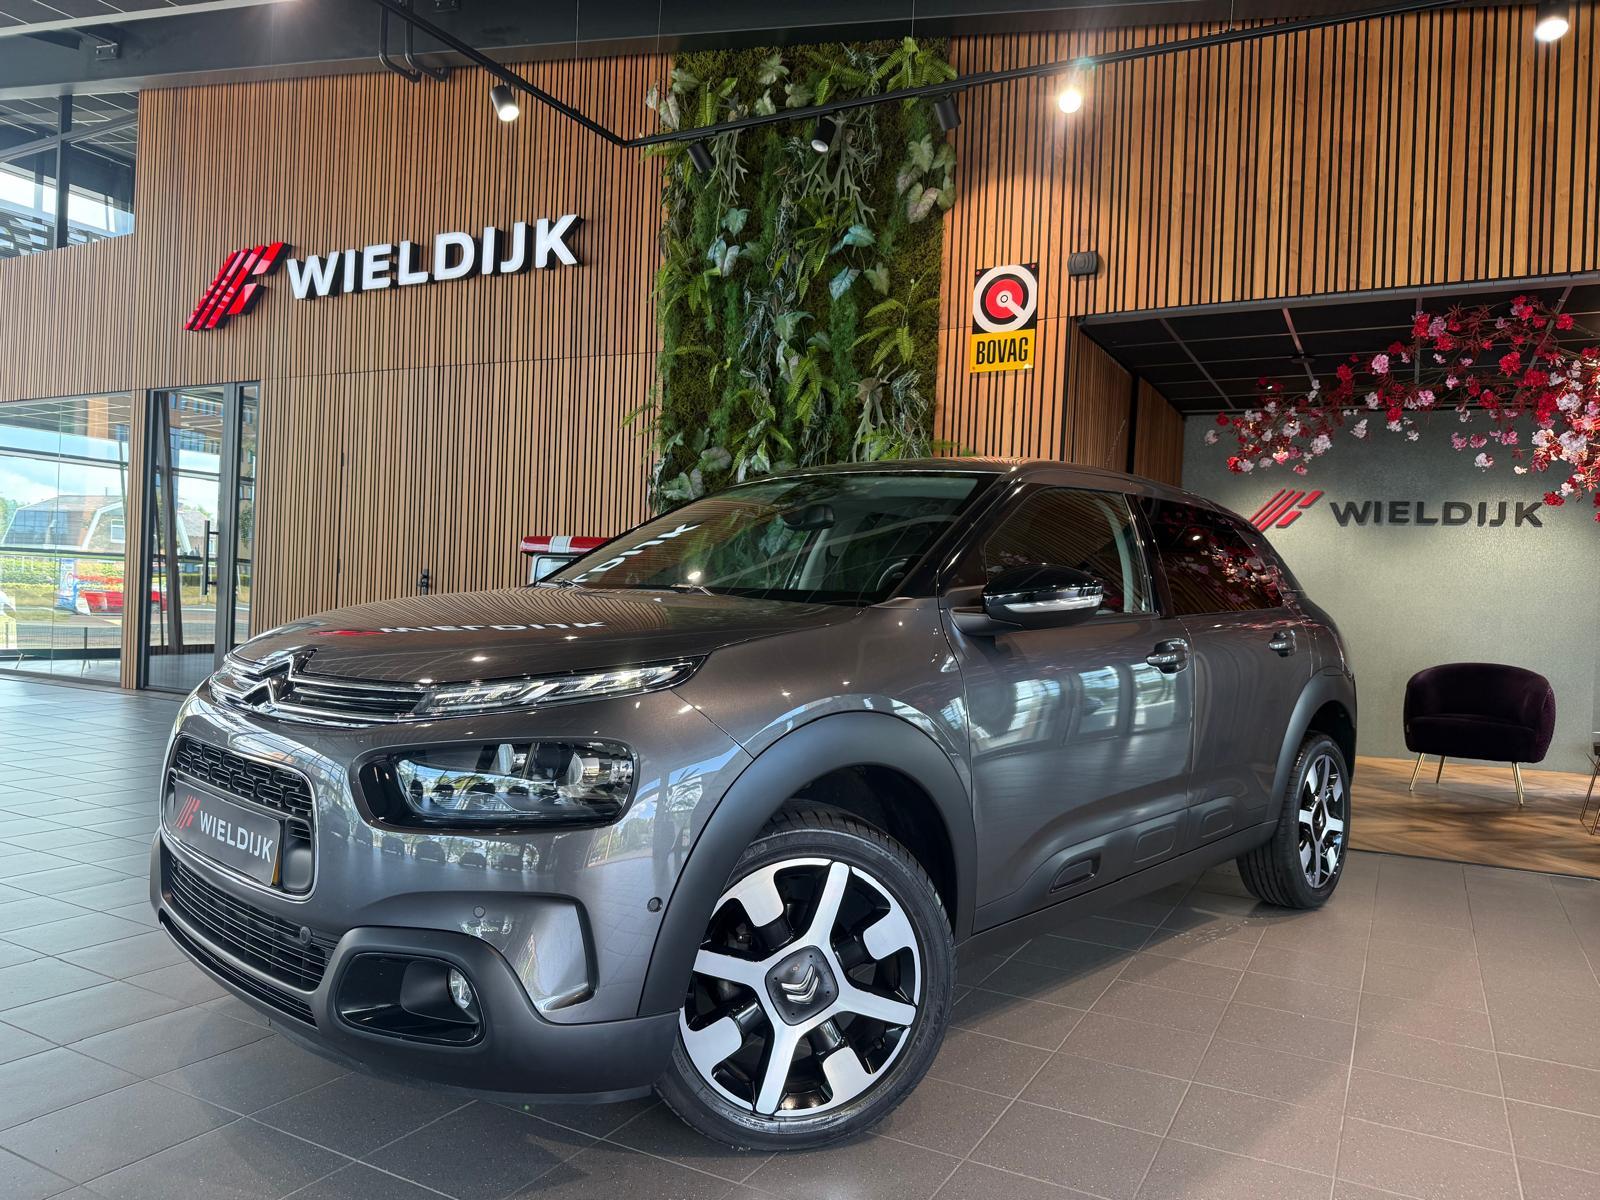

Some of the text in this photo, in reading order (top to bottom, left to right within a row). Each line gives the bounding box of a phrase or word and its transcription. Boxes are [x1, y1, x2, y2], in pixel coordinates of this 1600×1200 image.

[286, 213, 580, 300] WIELDIJK
[976, 337, 1029, 365] BOVAG
[1330, 501, 1544, 527] WIELDIJK
[200, 810, 274, 863] WIELDIJK
